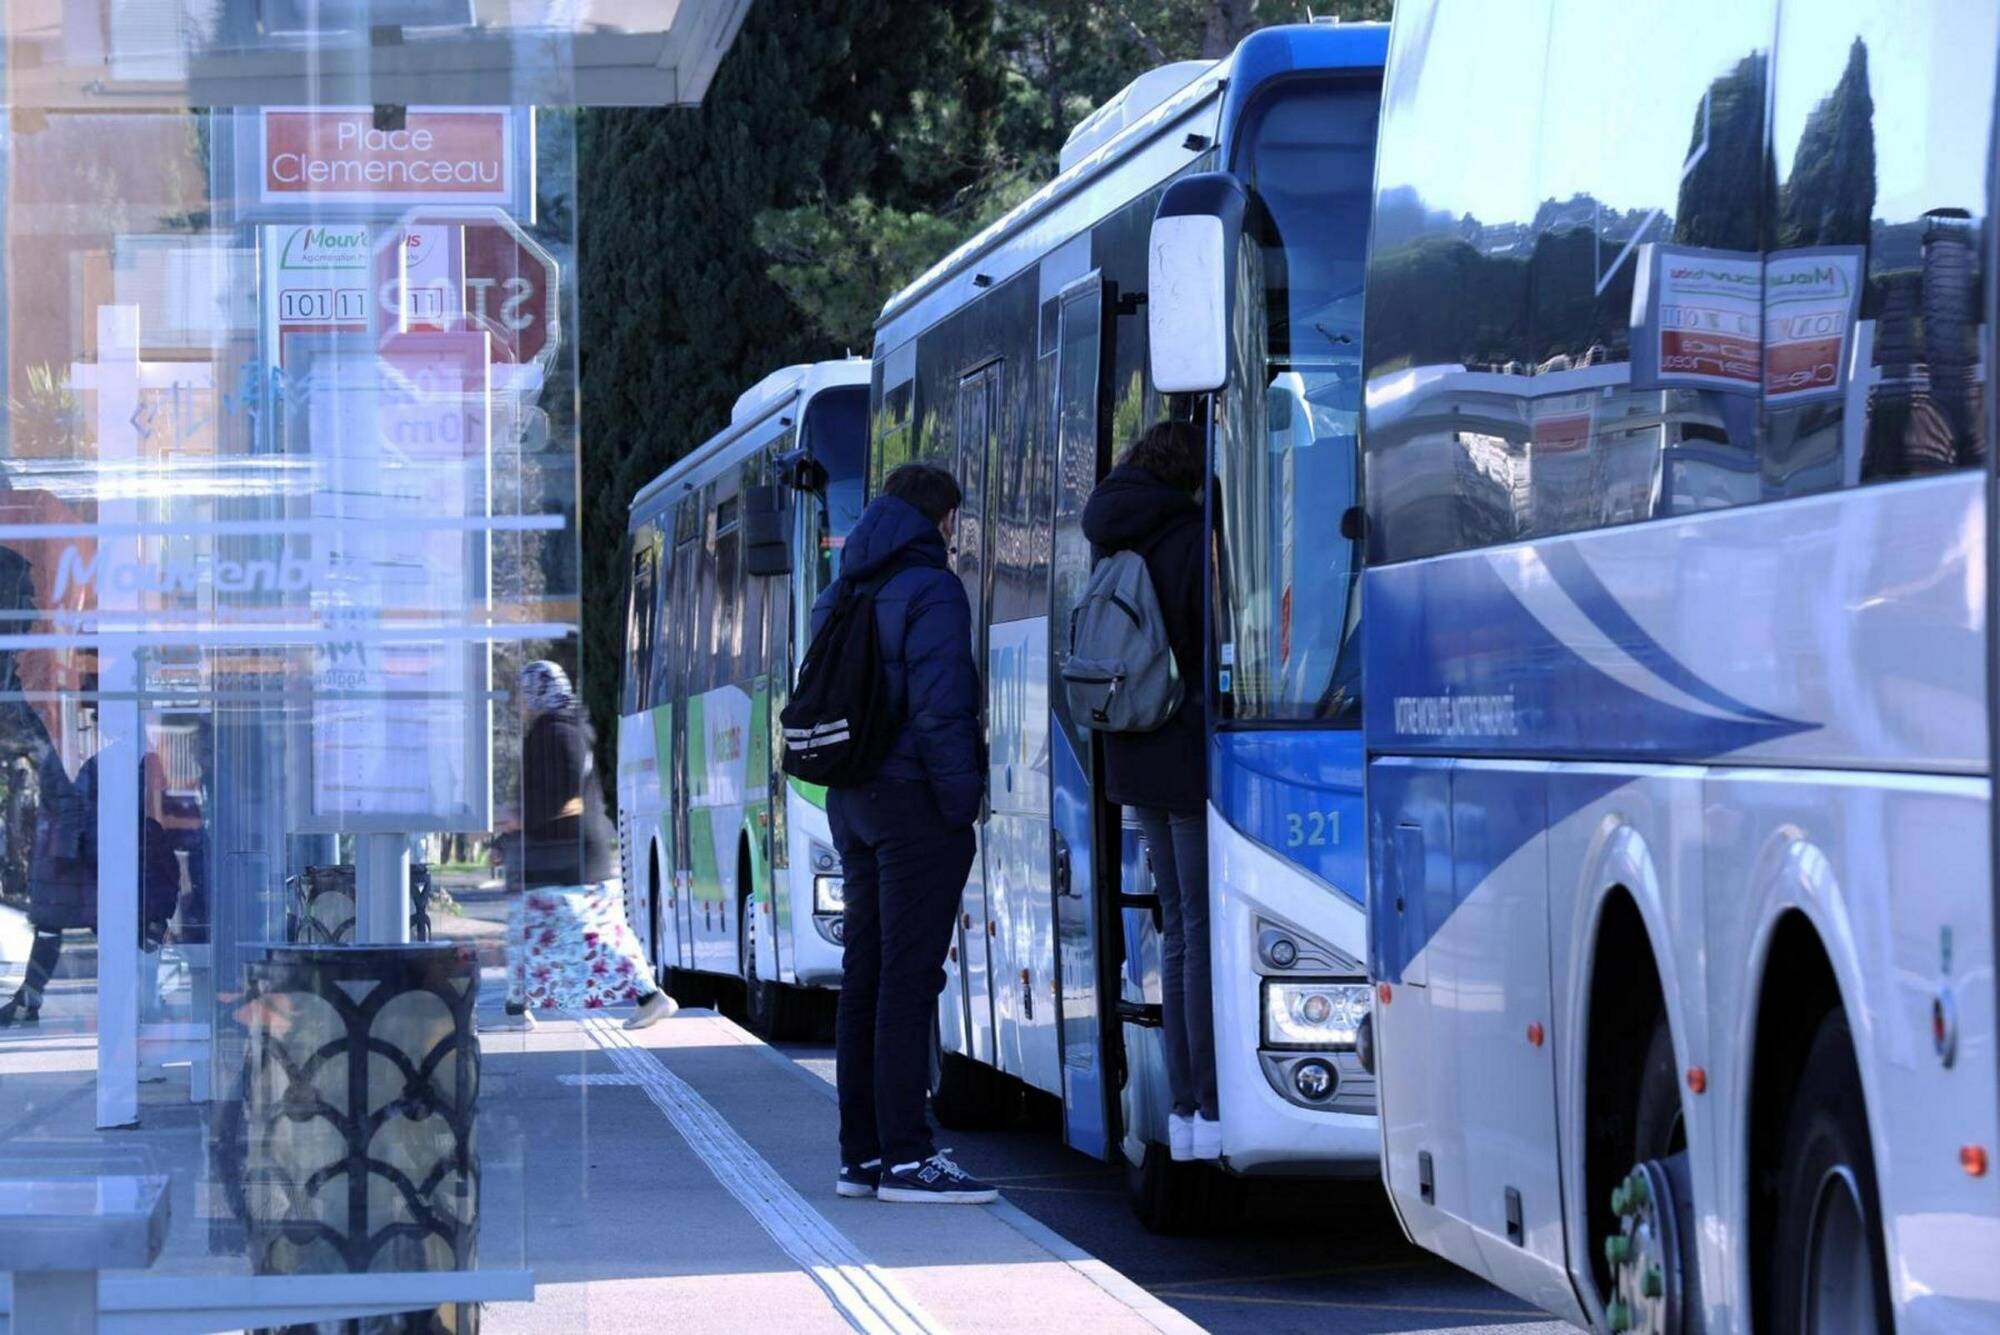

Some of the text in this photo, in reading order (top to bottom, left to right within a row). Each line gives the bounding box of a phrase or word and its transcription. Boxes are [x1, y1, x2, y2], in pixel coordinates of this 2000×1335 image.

[337, 122, 434, 151] Place
[271, 153, 499, 184] Clemenceau
[287, 294, 325, 316] 101
[1286, 811, 1341, 848] 321
